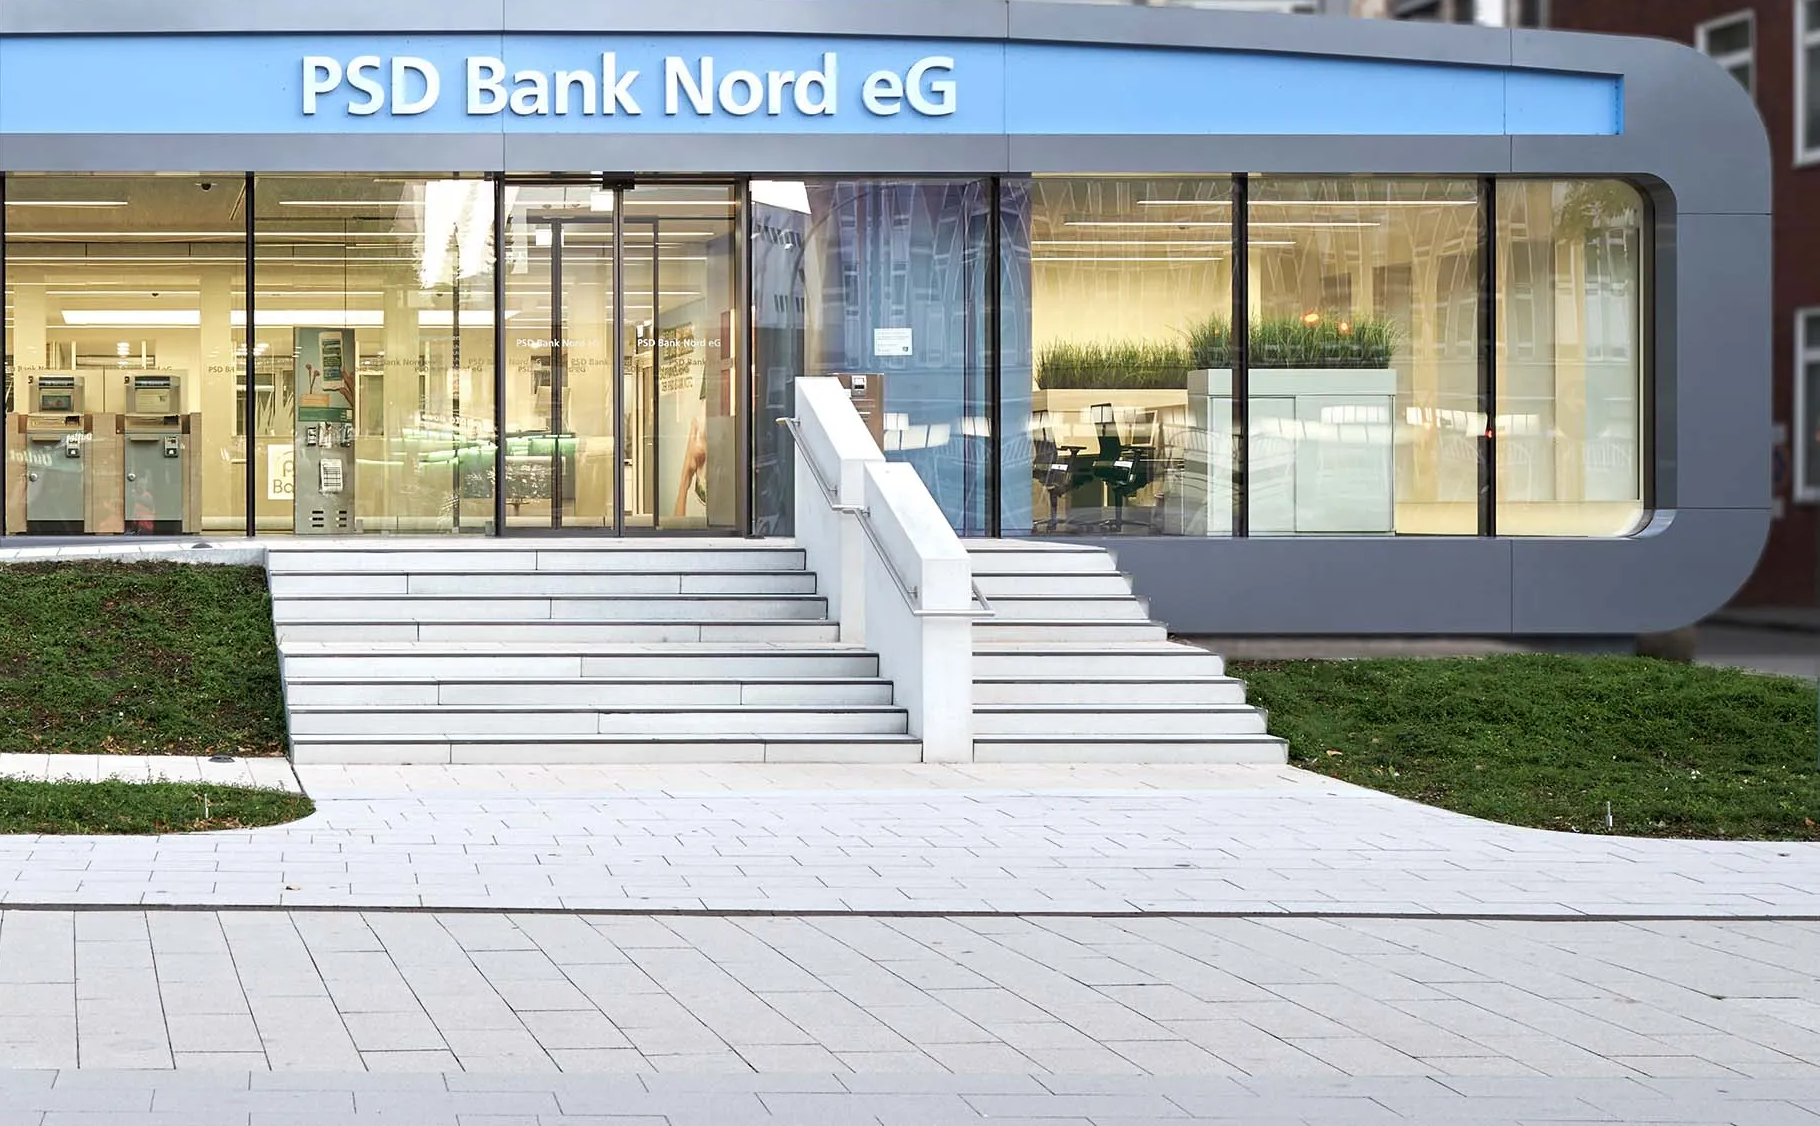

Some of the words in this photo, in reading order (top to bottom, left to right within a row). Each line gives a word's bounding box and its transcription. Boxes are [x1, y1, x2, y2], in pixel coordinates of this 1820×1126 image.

[301, 56, 441, 116] PSD
[466, 52, 642, 116] Bank
[664, 52, 838, 116] Nord
[861, 56, 957, 117] eG
[537, 338, 560, 347] Bank
[637, 338, 656, 347] PSD
[658, 338, 681, 347] Bank
[684, 338, 706, 347] Nord
[708, 339, 721, 347] eG
[273, 479, 294, 494] Ba
